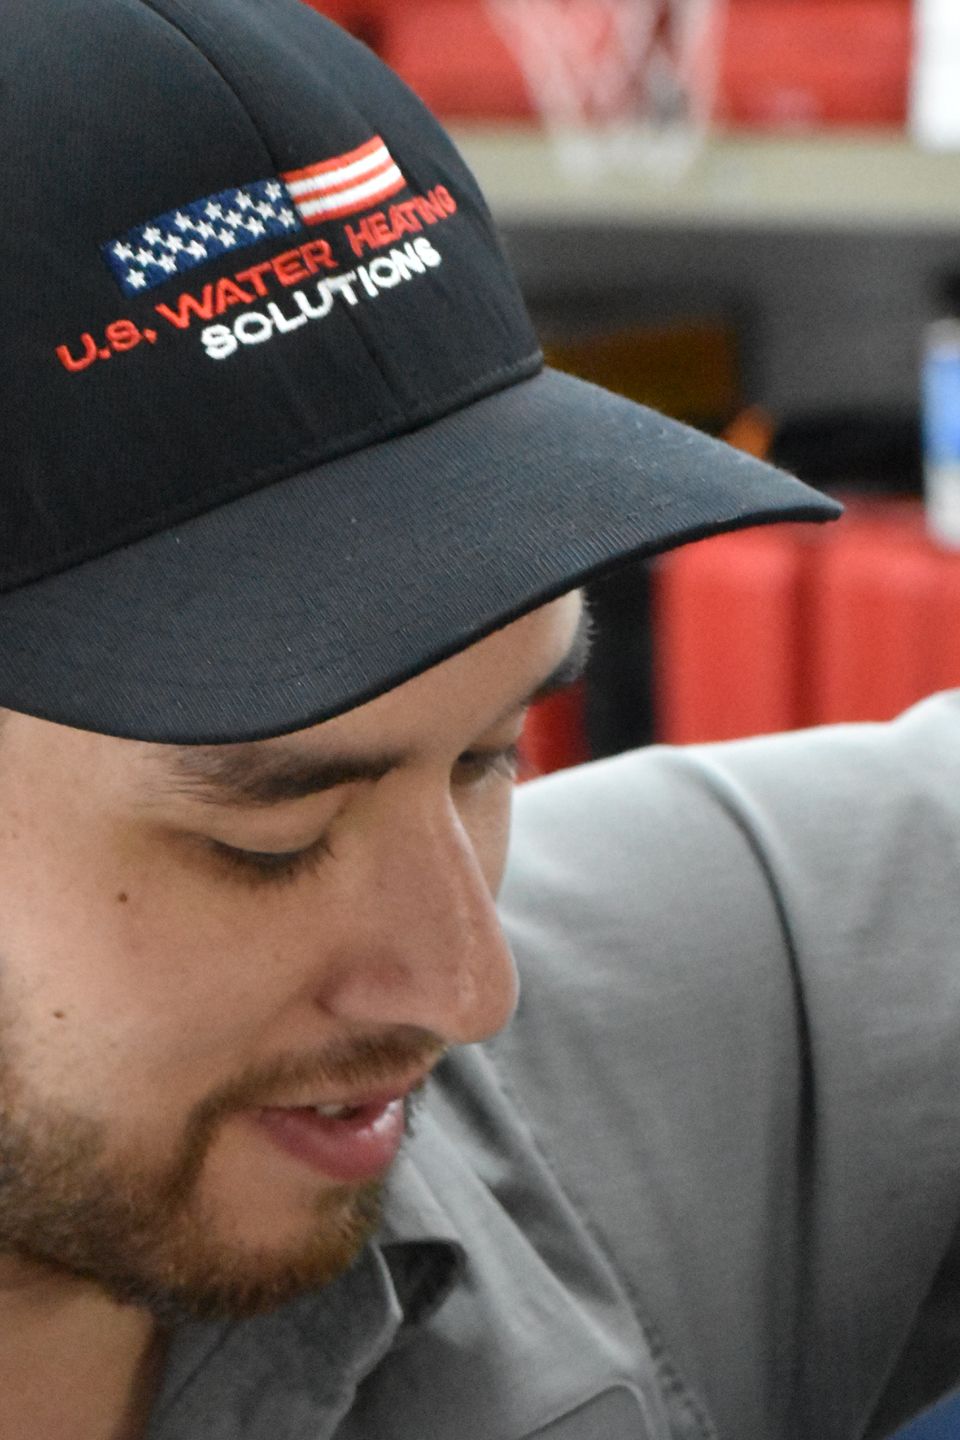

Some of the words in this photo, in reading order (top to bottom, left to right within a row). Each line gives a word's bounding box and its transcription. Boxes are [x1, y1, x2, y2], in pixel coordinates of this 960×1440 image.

[55, 319, 158, 372] U.S.
[156, 238, 338, 330] WATER
[344, 184, 458, 258] HEATING
[201, 237, 442, 361] SOLUTIONS
